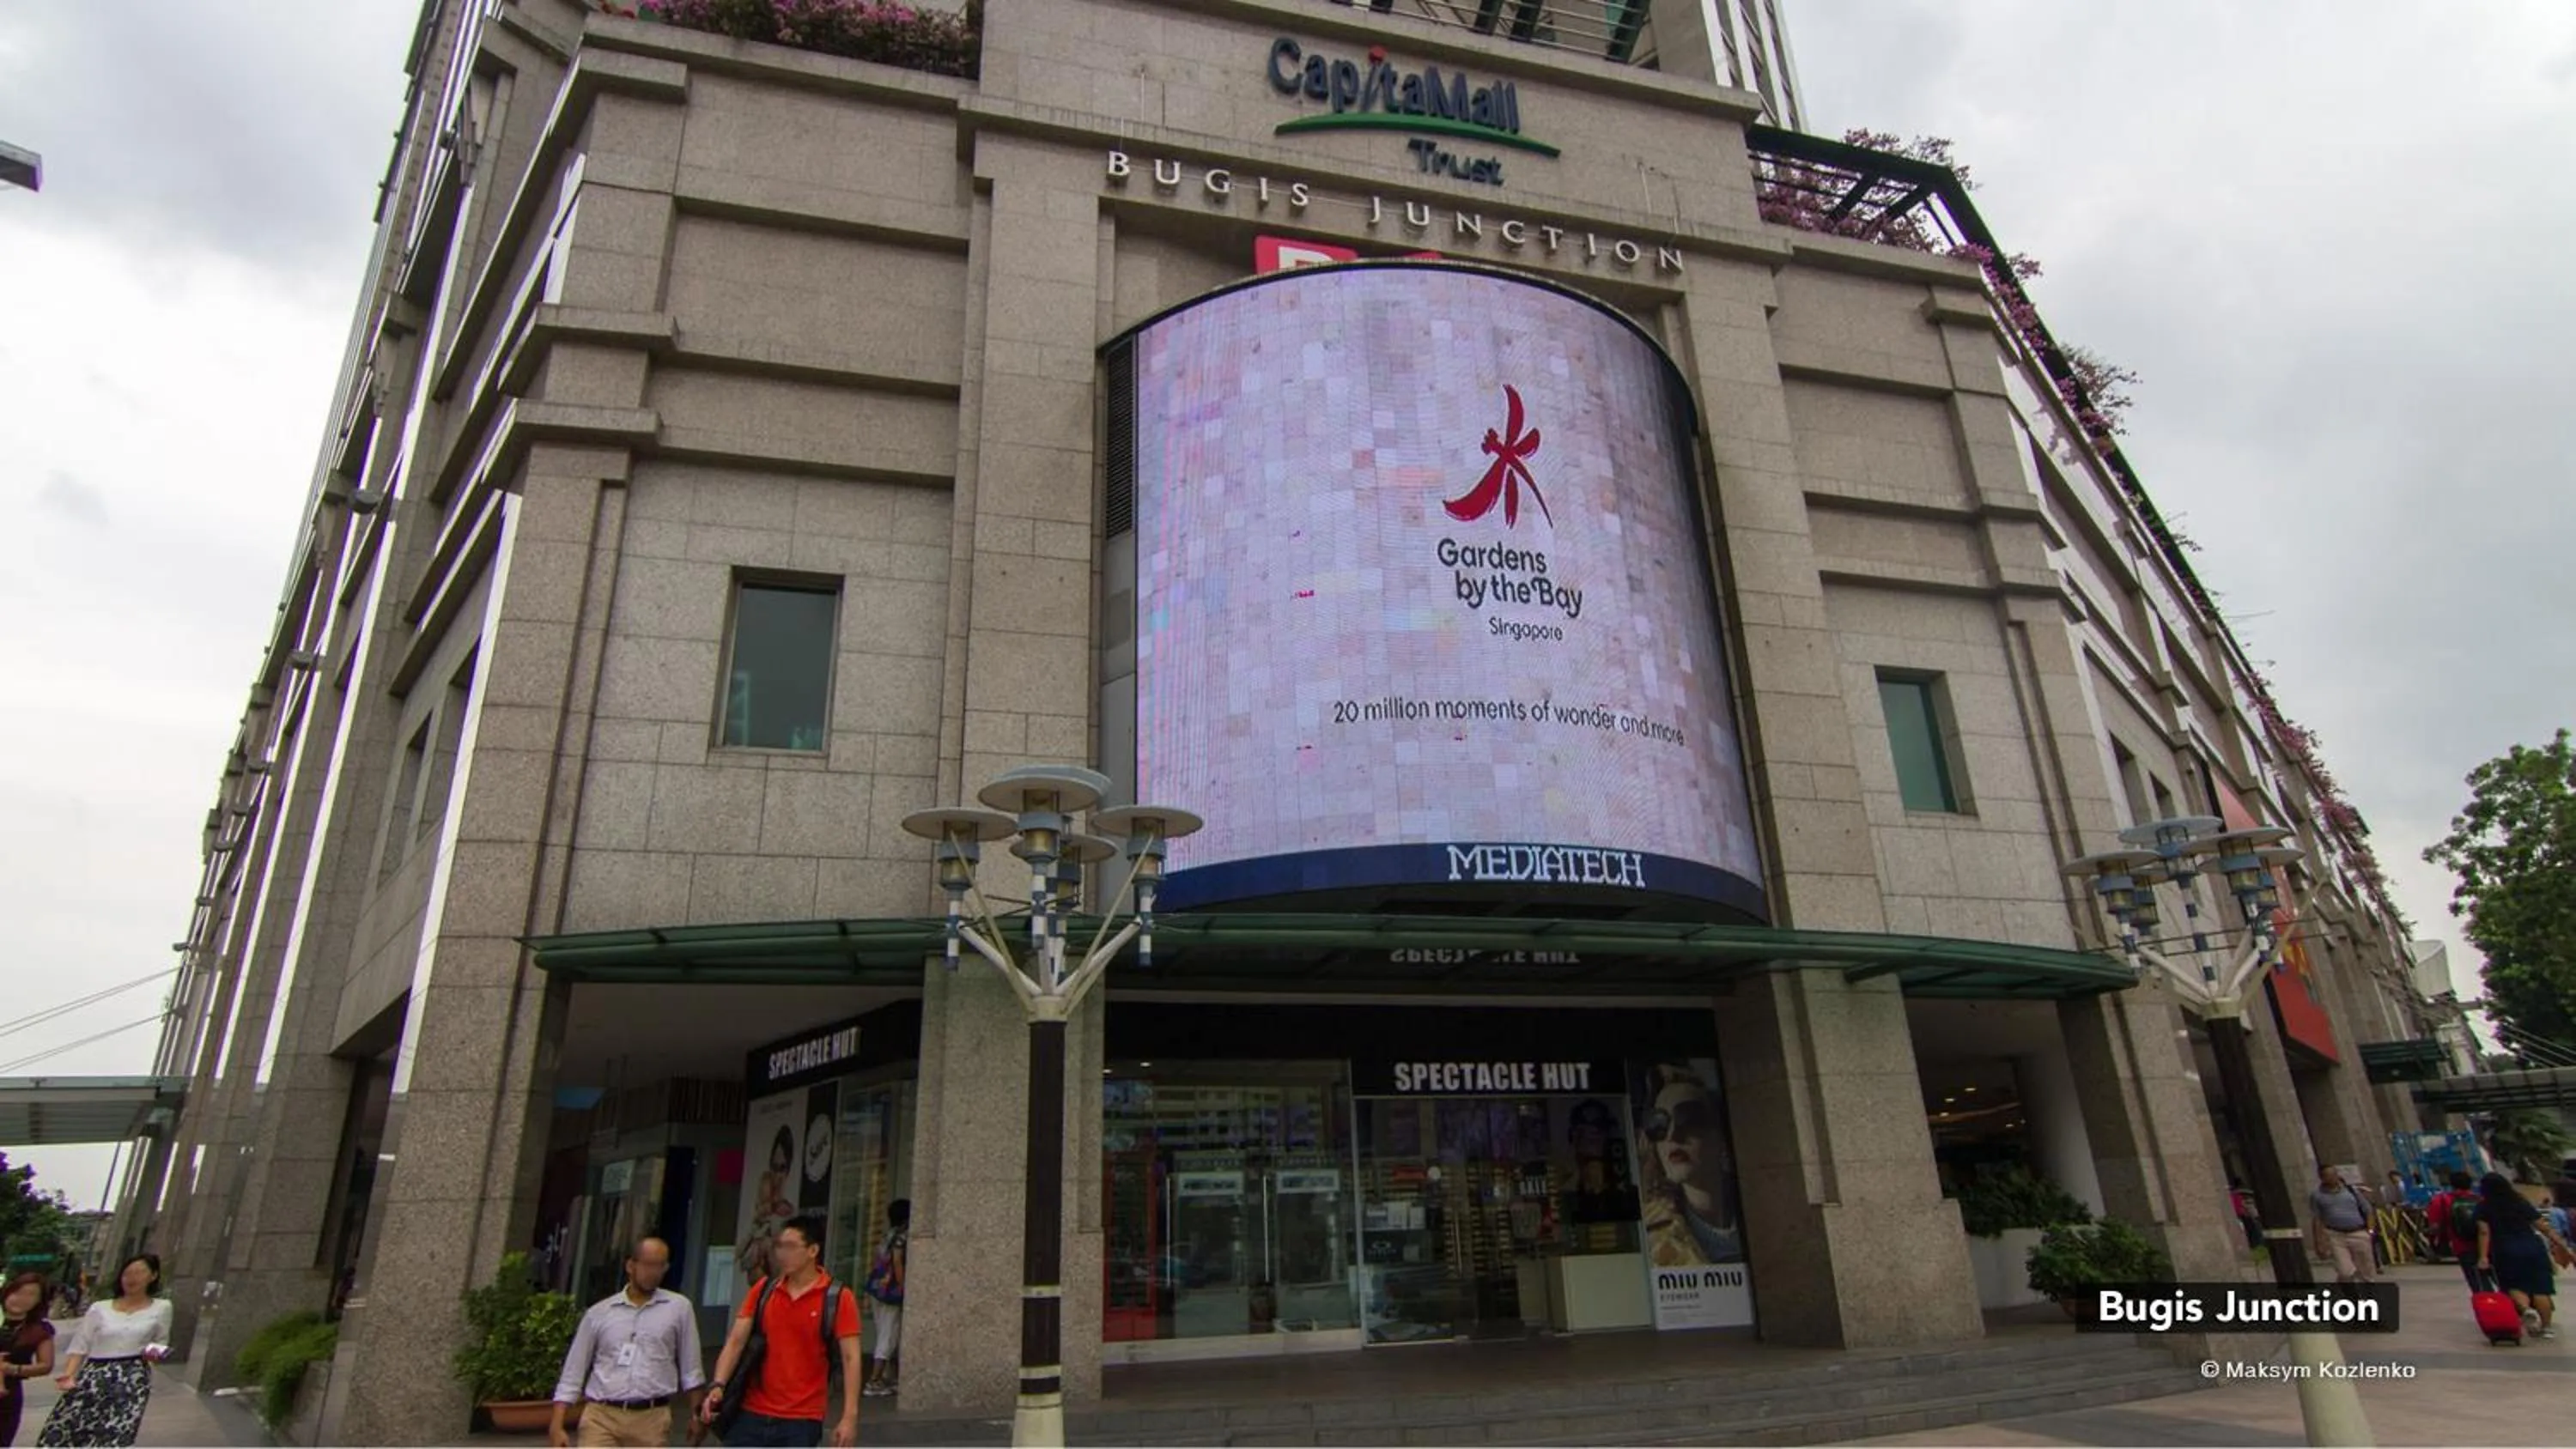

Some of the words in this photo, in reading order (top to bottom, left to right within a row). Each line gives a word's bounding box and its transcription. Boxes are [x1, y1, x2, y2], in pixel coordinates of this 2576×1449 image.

[1267, 37, 1520, 134] CapitaMall
[1407, 137, 1504, 185] Trust
[1108, 151, 1309, 207] BUGIS
[1371, 197, 1685, 272] JUNCTION
[1437, 537, 1546, 573] Gardens
[1455, 570, 1486, 609] by
[1491, 573, 1531, 604] the
[1531, 576, 1583, 618] Bay
[1489, 616, 1564, 641] Singapore
[1334, 700, 1358, 723] 20
[1364, 696, 1430, 720] million
[1436, 699, 1526, 721] moments
[1531, 700, 1550, 723] of
[1555, 707, 1615, 730] wonder
[1620, 713, 1649, 737] and
[1649, 726, 1685, 746] more
[1446, 845, 1647, 888] MEDIATECH
[768, 1035, 831, 1080] SPECTACLE
[831, 1027, 860, 1061] HUT
[1394, 1062, 1536, 1091] SPECTACLE
[1542, 1063, 1591, 1090] HUT
